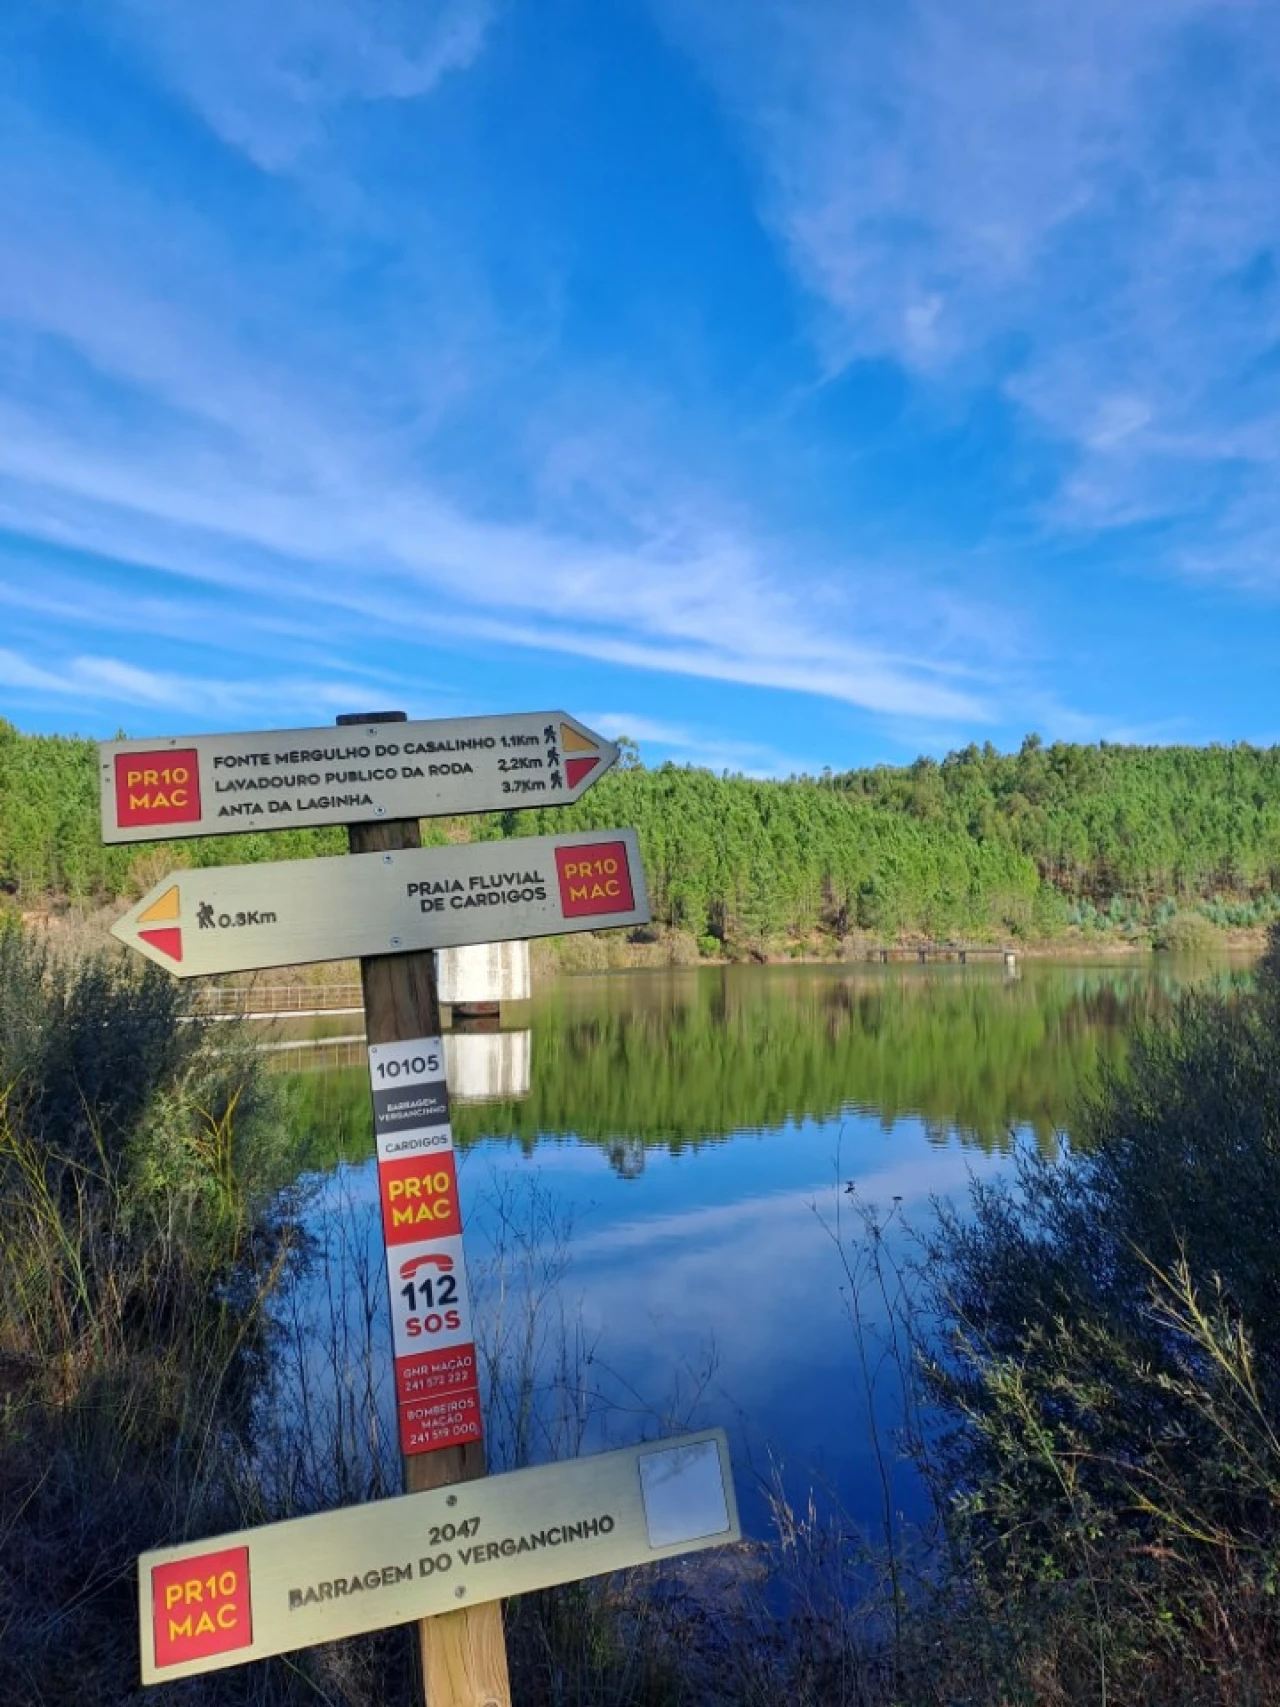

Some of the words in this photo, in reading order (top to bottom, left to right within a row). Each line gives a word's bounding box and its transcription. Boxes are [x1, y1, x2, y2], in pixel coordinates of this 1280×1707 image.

[213, 753, 271, 768] FONTE
[275, 746, 370, 766] MERGULHO
[375, 741, 399, 756] DO
[403, 737, 495, 754] CASALINHO
[127, 767, 190, 788] PR10
[215, 773, 320, 792] LAVADOURO
[325, 767, 397, 784] PUBLICO
[402, 767, 424, 779] DA
[429, 762, 473, 776] RODA
[130, 789, 188, 810] MAC
[218, 803, 264, 817] ANTA
[268, 800, 292, 814] DA
[296, 794, 373, 810] LAGINHA
[564, 858, 617, 879] PR10
[407, 879, 464, 897] PRAIA
[469, 870, 545, 890] FLUVIAL
[569, 879, 620, 902] MAC
[421, 898, 445, 913] DE
[451, 887, 547, 909] CARDIGOS
[376, 1054, 440, 1079] 10105
[385, 1134, 448, 1153] CARDIGOS
[388, 1172, 450, 1202] PR10
[392, 1199, 451, 1228] MAC
[401, 1274, 458, 1311] 112
[406, 1310, 461, 1337] SOS
[406, 1398, 475, 1420] BOMBEIROS
[410, 1432, 429, 1444] 241
[428, 1516, 481, 1546] 2047
[289, 1563, 412, 1611] BARRAGEM
[419, 1553, 452, 1578] DO
[458, 1514, 615, 1566] VERGANCINHO
[166, 1571, 237, 1610] PR10
[168, 1604, 238, 1642] MAC
